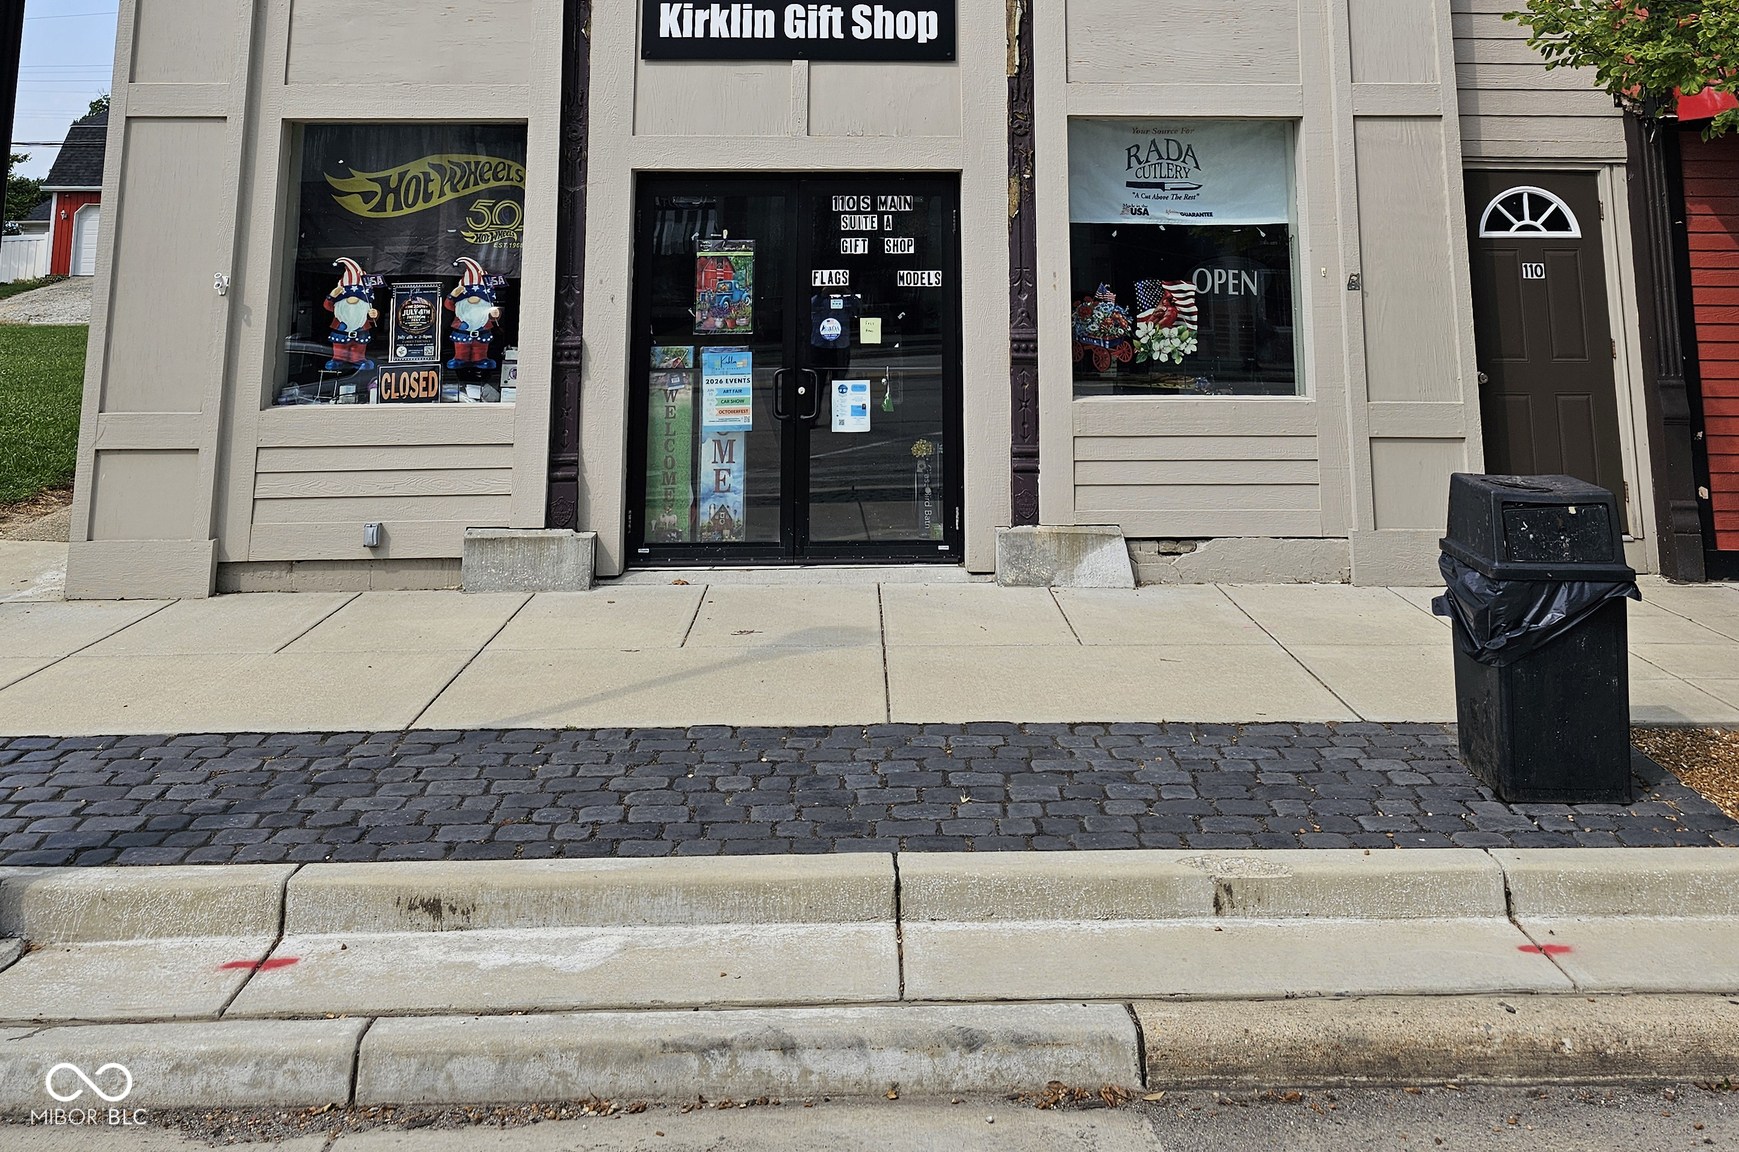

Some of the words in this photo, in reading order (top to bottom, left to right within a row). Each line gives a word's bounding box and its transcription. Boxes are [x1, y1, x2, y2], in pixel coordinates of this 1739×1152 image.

[659, 2, 776, 39] Kirklin
[783, 3, 844, 40] Gift
[851, 4, 938, 44] Shop
[1125, 138, 1202, 171] RADA
[1135, 162, 1191, 179] CUTLERY
[833, 196, 856, 210] 110
[861, 196, 870, 210] S
[878, 196, 913, 210] MAIN
[1130, 208, 1149, 216] USA
[842, 215, 877, 230] SUITE
[885, 216, 892, 230] A
[842, 239, 868, 253] GIFT
[885, 239, 914, 253] SHOP
[813, 271, 848, 285] FLAGS
[898, 272, 941, 286] MODELS
[1523, 264, 1544, 278] 110
[1192, 268, 1258, 295] OPEN
[381, 370, 438, 400] CLOSED
[661, 389, 678, 501] WELCOME
